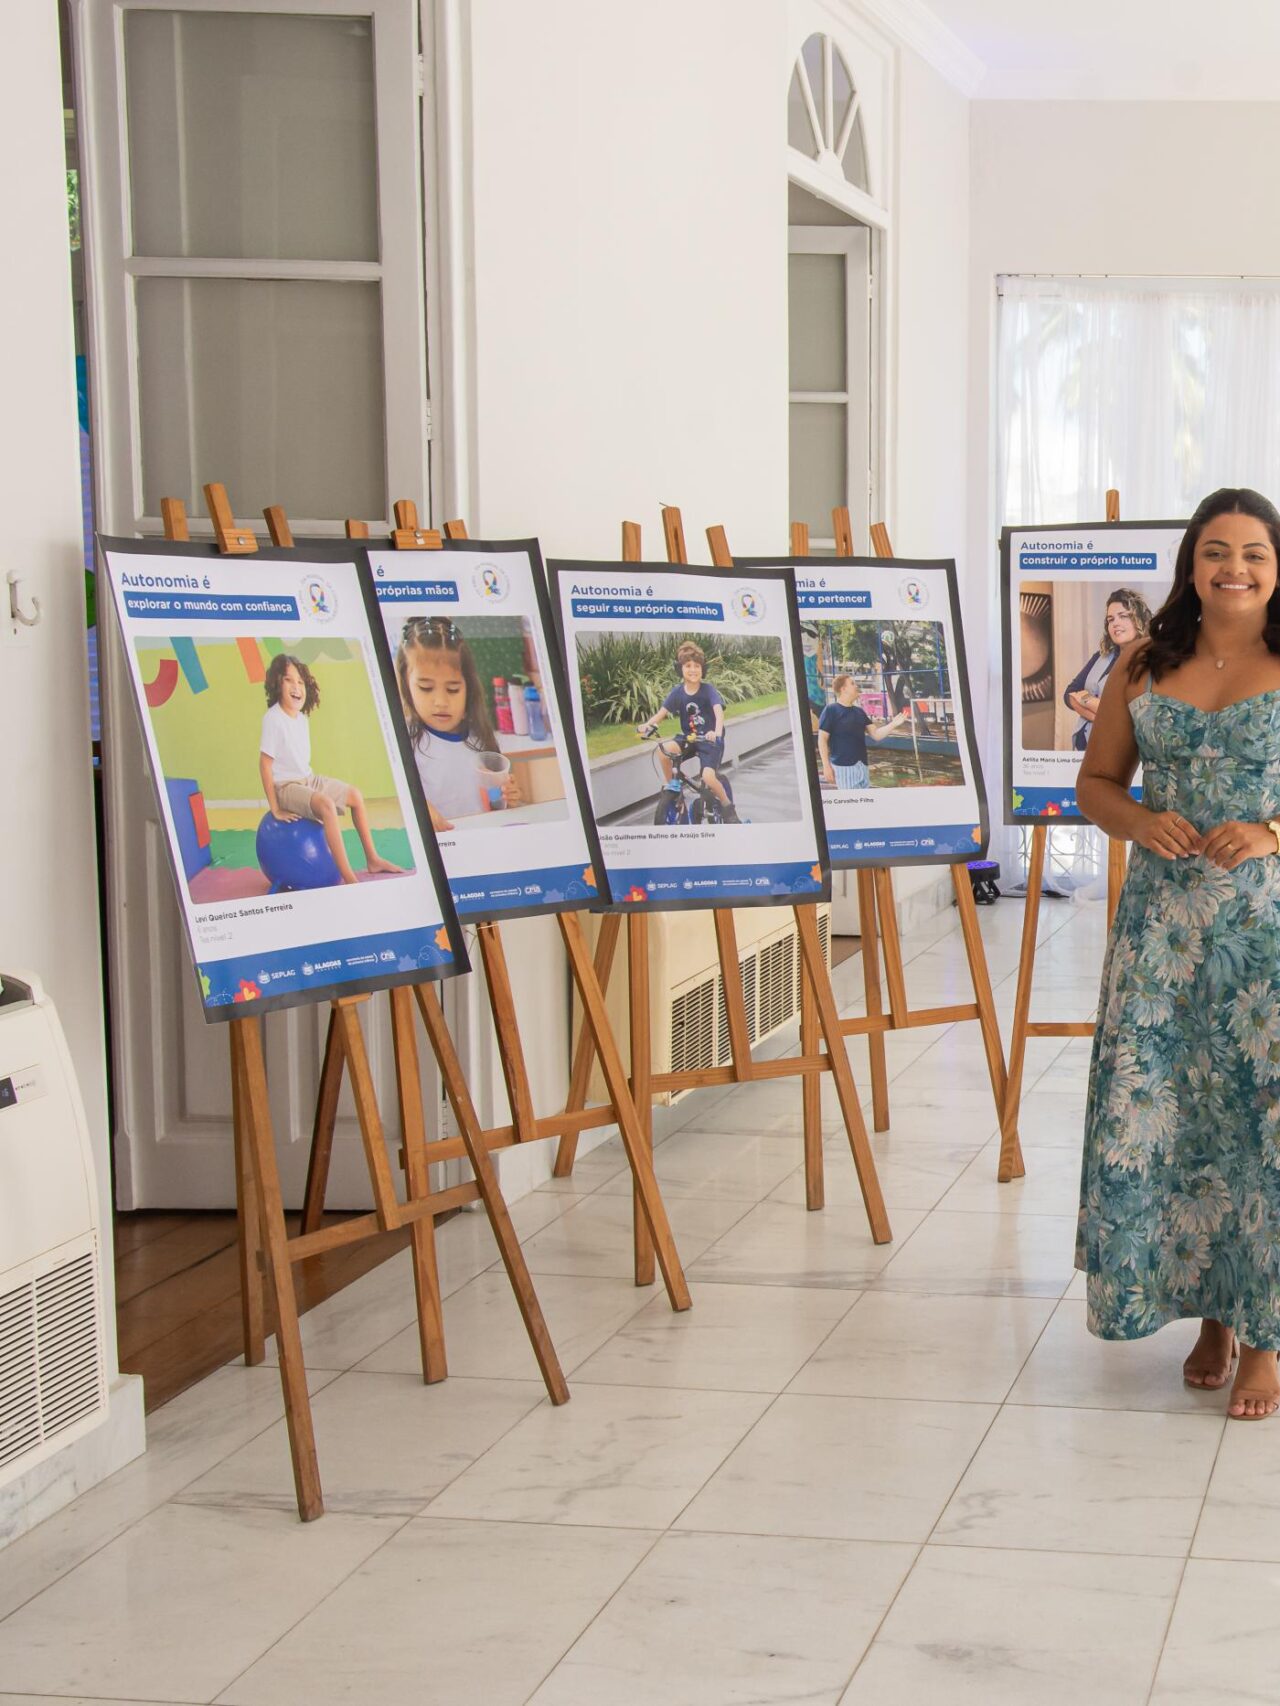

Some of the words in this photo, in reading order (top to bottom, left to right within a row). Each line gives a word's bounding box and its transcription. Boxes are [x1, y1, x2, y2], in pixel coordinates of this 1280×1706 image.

[1021, 541, 1083, 550] Autonomia
[1087, 540, 1094, 550] é
[1022, 556, 1068, 565] construir
[1080, 555, 1118, 566] próprio
[1121, 556, 1152, 565] futuro
[377, 566, 384, 577] é
[122, 572, 199, 589] Autonomia
[203, 576, 210, 589] é
[820, 578, 826, 588] é
[376, 585, 422, 597] próprias
[425, 585, 454, 595] mãos
[572, 585, 642, 596] Autonomia
[646, 586, 653, 596] é
[818, 595, 866, 604] pertencer
[128, 598, 170, 611] explorar
[184, 600, 218, 611] mundo
[221, 603, 243, 612] com
[245, 602, 292, 614] confiança
[576, 603, 610, 614] seguir
[613, 605, 632, 613] seu
[634, 603, 674, 616] próprio
[677, 605, 718, 616] caminho
[209, 912, 237, 922] Queiroz
[239, 908, 263, 917] Santos
[265, 903, 293, 912] Ferreira
[271, 969, 296, 980] SEPLAG
[314, 960, 342, 970] ALAGOAS
